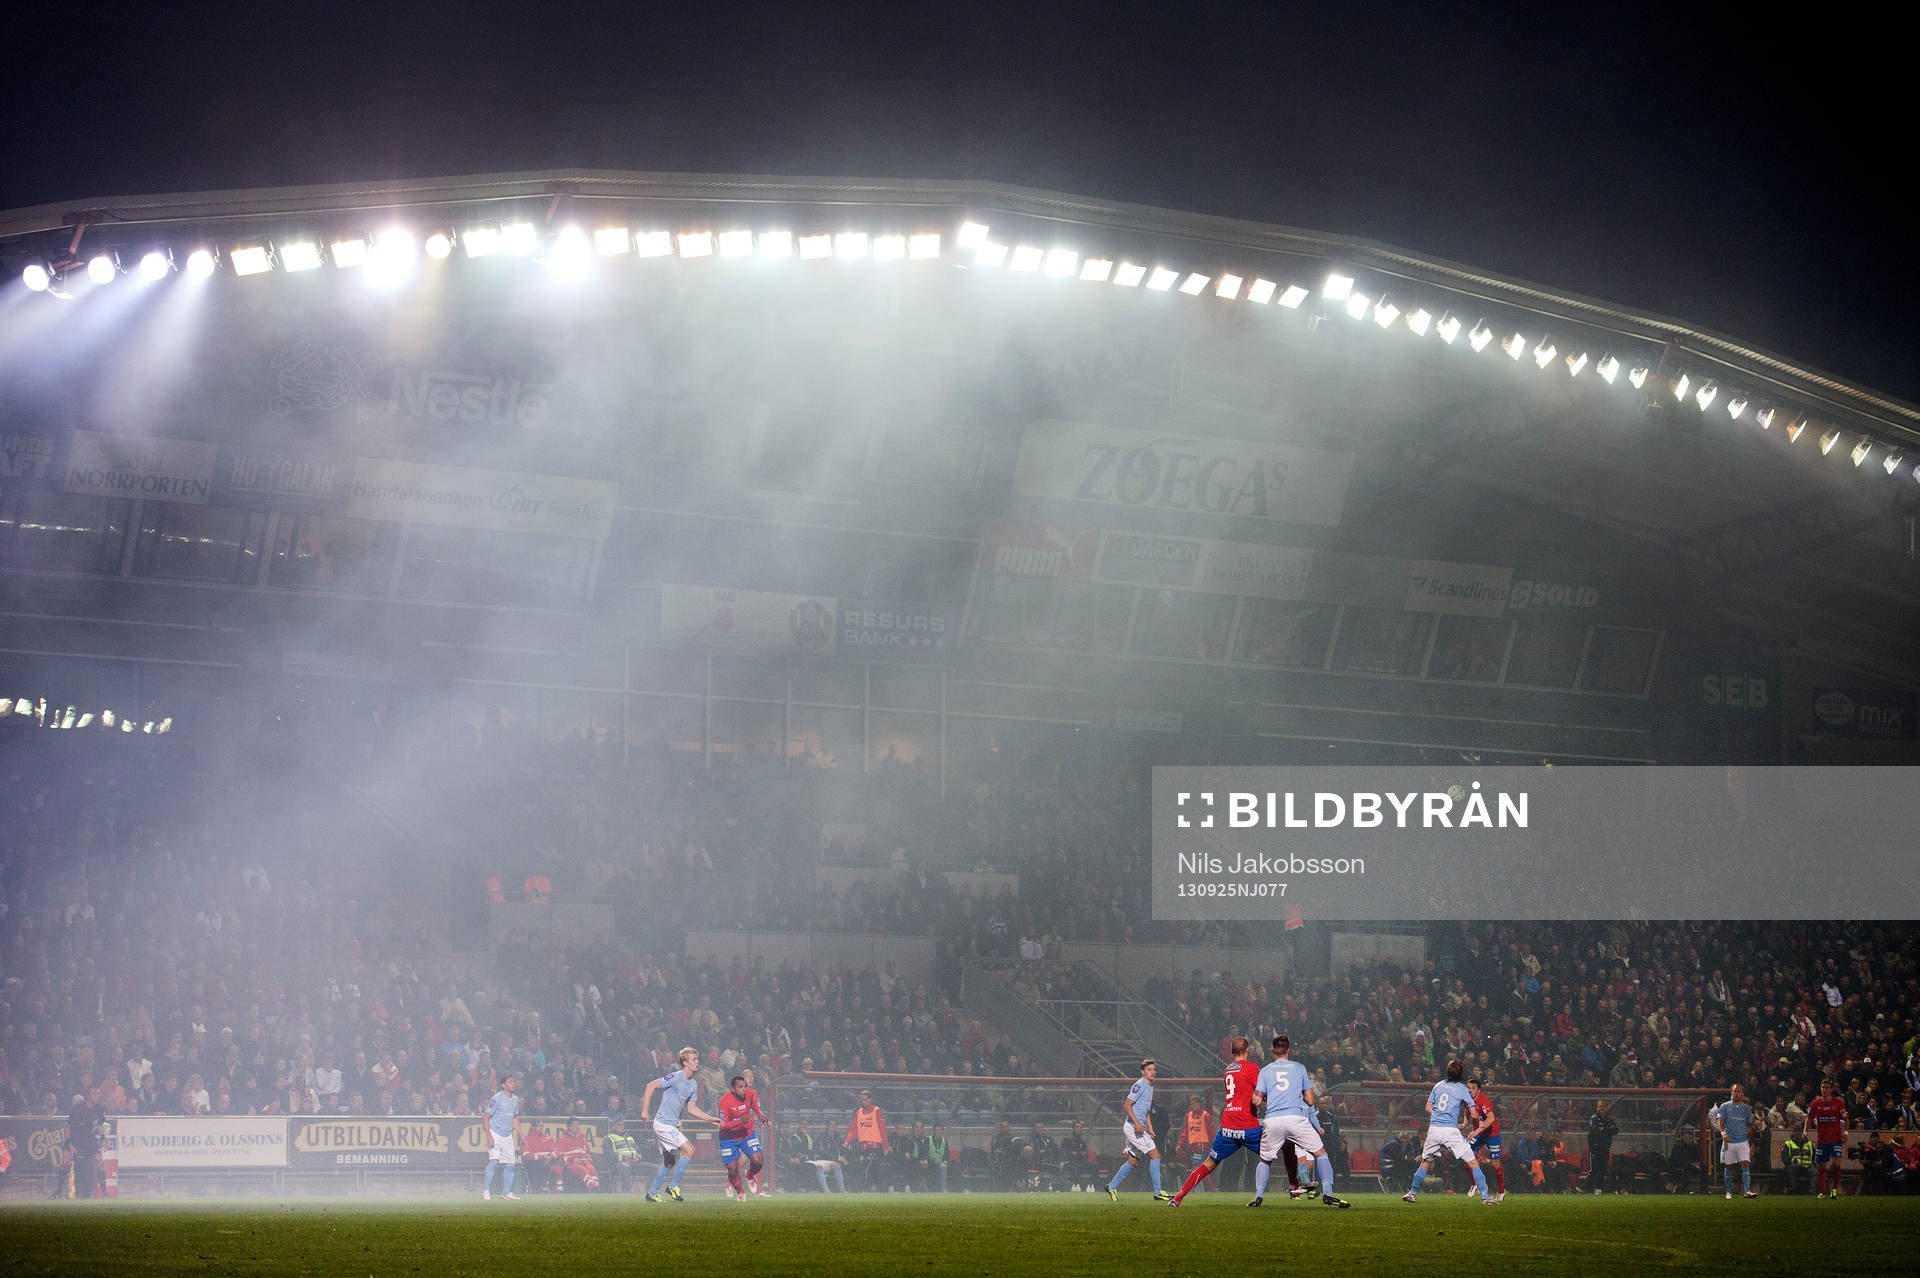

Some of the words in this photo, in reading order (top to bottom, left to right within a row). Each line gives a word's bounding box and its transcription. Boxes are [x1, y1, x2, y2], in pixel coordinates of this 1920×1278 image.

[67, 467, 210, 498] NORRPORTEN
[353, 481, 483, 509] Handelsbanken
[1428, 578, 1507, 601] Scandlines
[845, 610, 945, 633] RESURS
[845, 629, 903, 648] BANK
[1703, 674, 1768, 708] SEB
[1225, 1074, 1236, 1100] 9
[1275, 1071, 1290, 1092] 5
[1438, 1092, 1449, 1112] 8
[121, 1134, 202, 1148] LUNDBERG
[204, 1134, 216, 1147] &
[223, 1133, 285, 1147] OLSSONS
[306, 1125, 440, 1147] UTBILDARNA
[336, 1154, 409, 1164] BEMANNING
